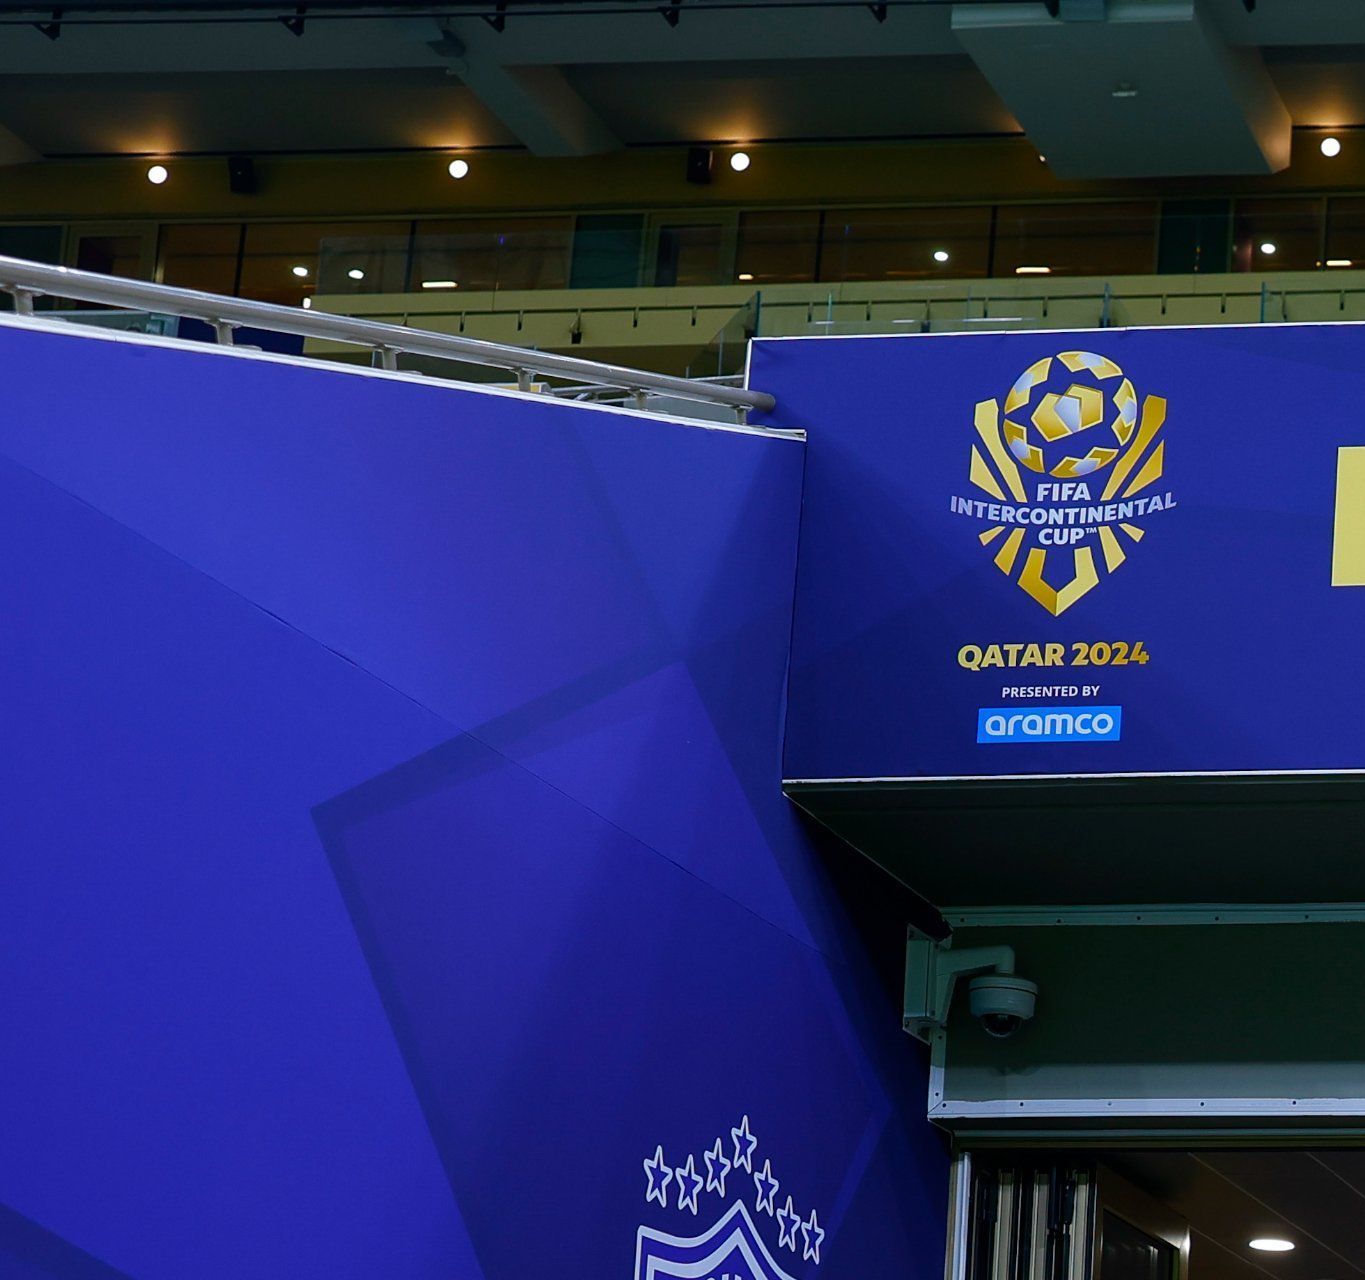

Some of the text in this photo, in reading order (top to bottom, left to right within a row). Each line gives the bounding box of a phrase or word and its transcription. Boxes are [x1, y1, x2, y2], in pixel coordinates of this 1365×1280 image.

[1036, 482, 1091, 502] FIFA
[950, 491, 1177, 525] INTERCONTINENTAL
[957, 640, 1150, 671] QATAR 2024
[1002, 685, 1100, 699] PRESENTED BY
[985, 713, 1114, 736] aramco
